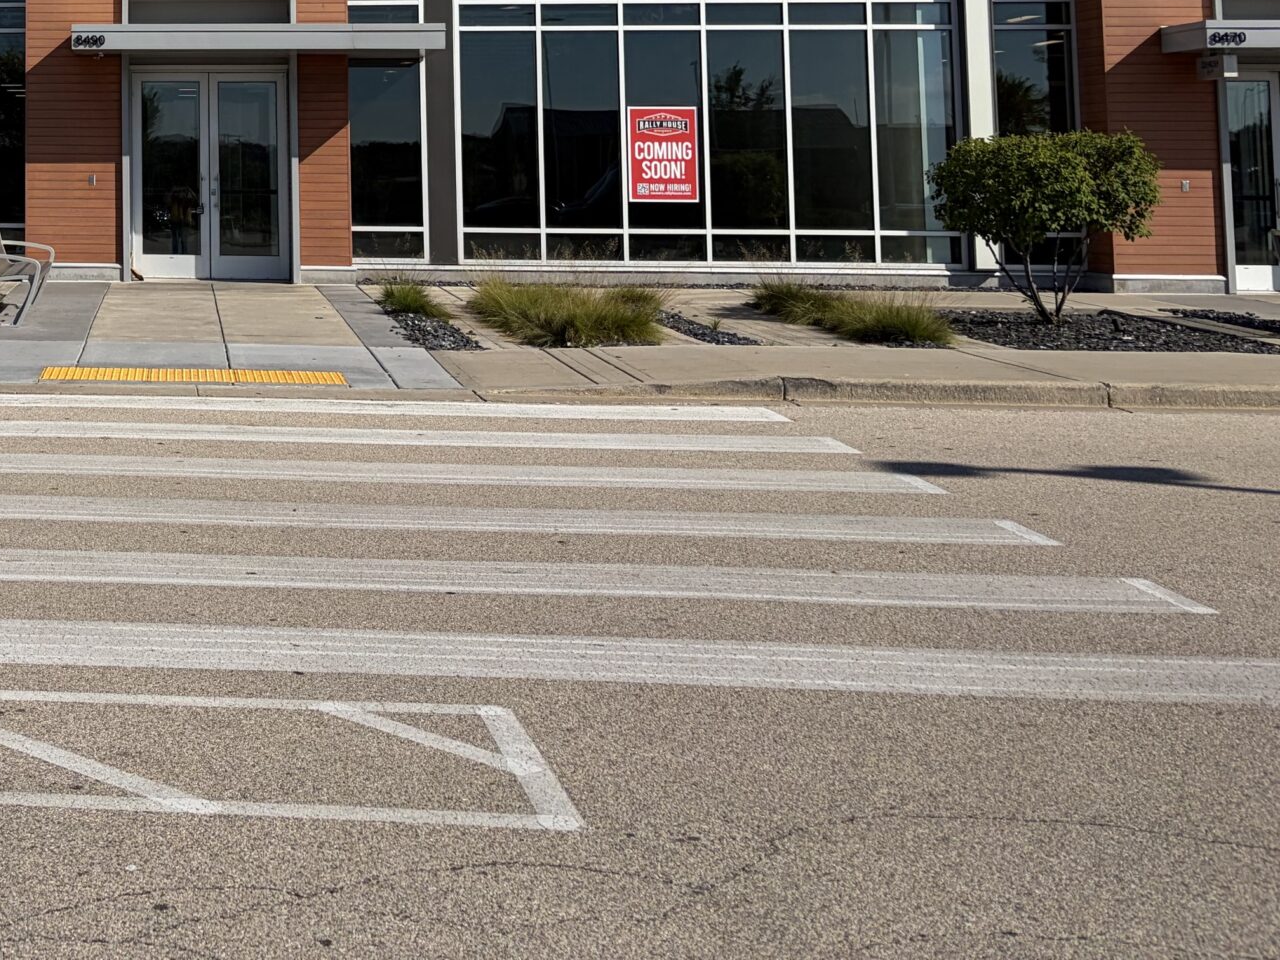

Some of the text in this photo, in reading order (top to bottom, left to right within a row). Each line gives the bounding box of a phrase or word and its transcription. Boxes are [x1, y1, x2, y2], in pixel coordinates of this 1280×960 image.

[639, 121, 661, 130] RALLY
[662, 121, 686, 131] HOUSE
[635, 142, 692, 160] COMING
[642, 161, 686, 179] SOON!
[650, 184, 692, 192] NOW HIRING!
